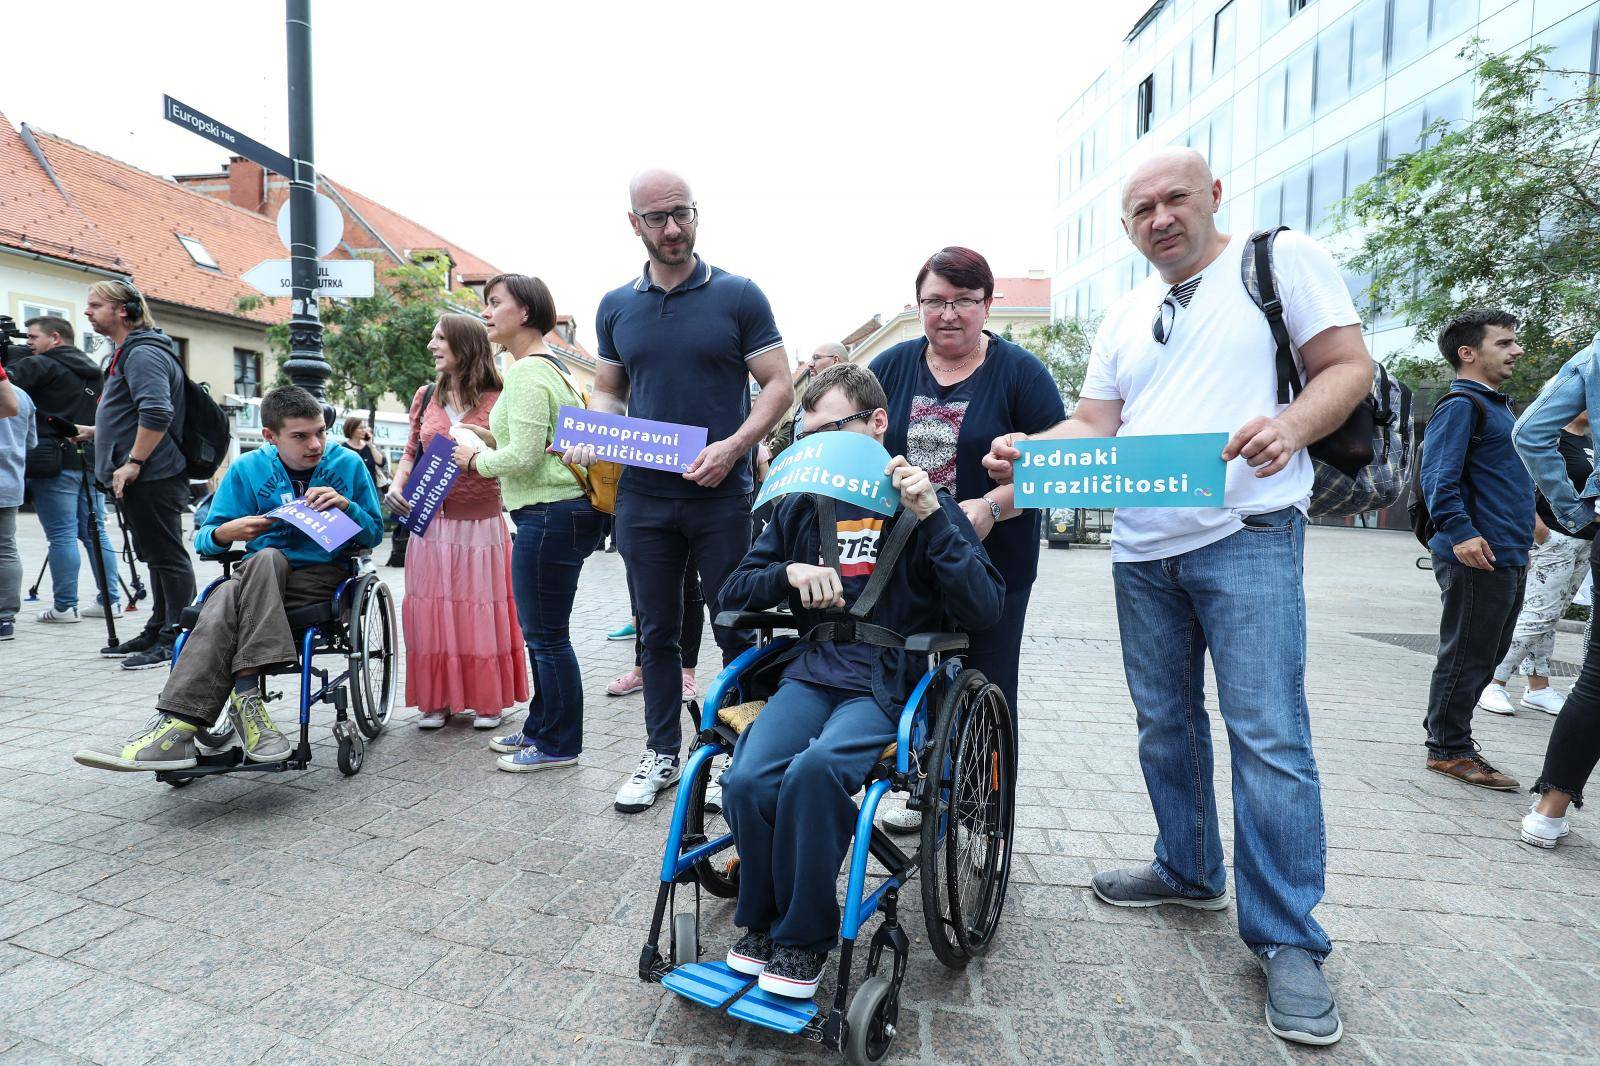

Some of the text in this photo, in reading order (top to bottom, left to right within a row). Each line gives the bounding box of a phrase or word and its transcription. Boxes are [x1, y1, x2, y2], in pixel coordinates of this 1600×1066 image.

[172, 103, 236, 143] Europski TRG
[317, 279, 343, 288] UTRKA
[559, 438, 571, 450] u
[563, 417, 679, 447] Ravnopravni
[1021, 446, 1118, 468] Jednaki
[398, 454, 442, 524] Rnopravni
[413, 461, 458, 533] u različitosti
[1022, 473, 1188, 495] u različitosti
